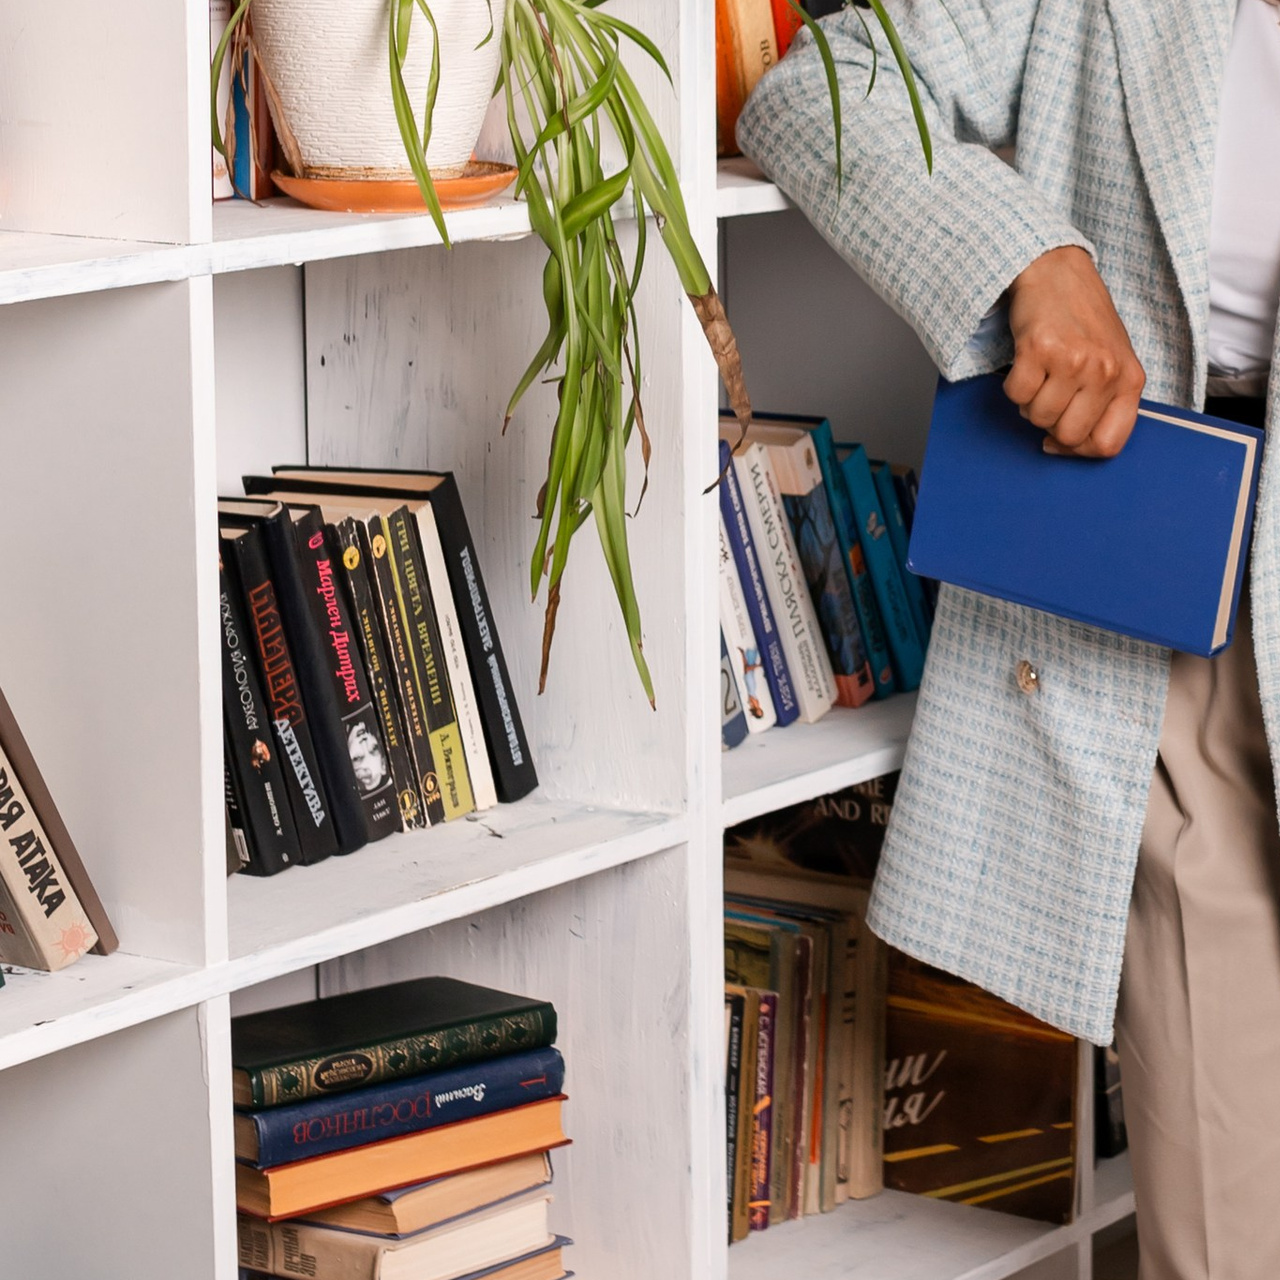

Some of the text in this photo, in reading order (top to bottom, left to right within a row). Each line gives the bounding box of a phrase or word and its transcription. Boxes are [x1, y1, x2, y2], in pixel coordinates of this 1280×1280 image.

[749, 463, 783, 551] СМЕРТИ
[315, 560, 361, 703] Марлен Дитрих
[394, 519, 443, 707] ТРИ ЦВЕТА ВРЕМЕНИ
[773, 552, 805, 639] ПЛЯСКА
[230, 650, 259, 731] АРХЕОЛОГИЯ
[249, 579, 304, 728] МАСТЕРА
[361, 608, 399, 747] ДЕТЕКТИВ ПОЛИТИКА
[388, 599, 424, 737] ДЕТЕКТИВ ПОЛИТИКА
[768, 641, 794, 711] МАРК ТВЕН
[273, 718, 325, 828] ДЕТЕКТИВА
[814, 798, 861, 821] AND
[9, 828, 66, 919] АТАКА
[292, 1081, 488, 1145] Василий РОСЛЯКОВ
[283, 1226, 300, 1278] ВЕЧНЫЙ
[300, 1250, 316, 1278] ЗОВ
